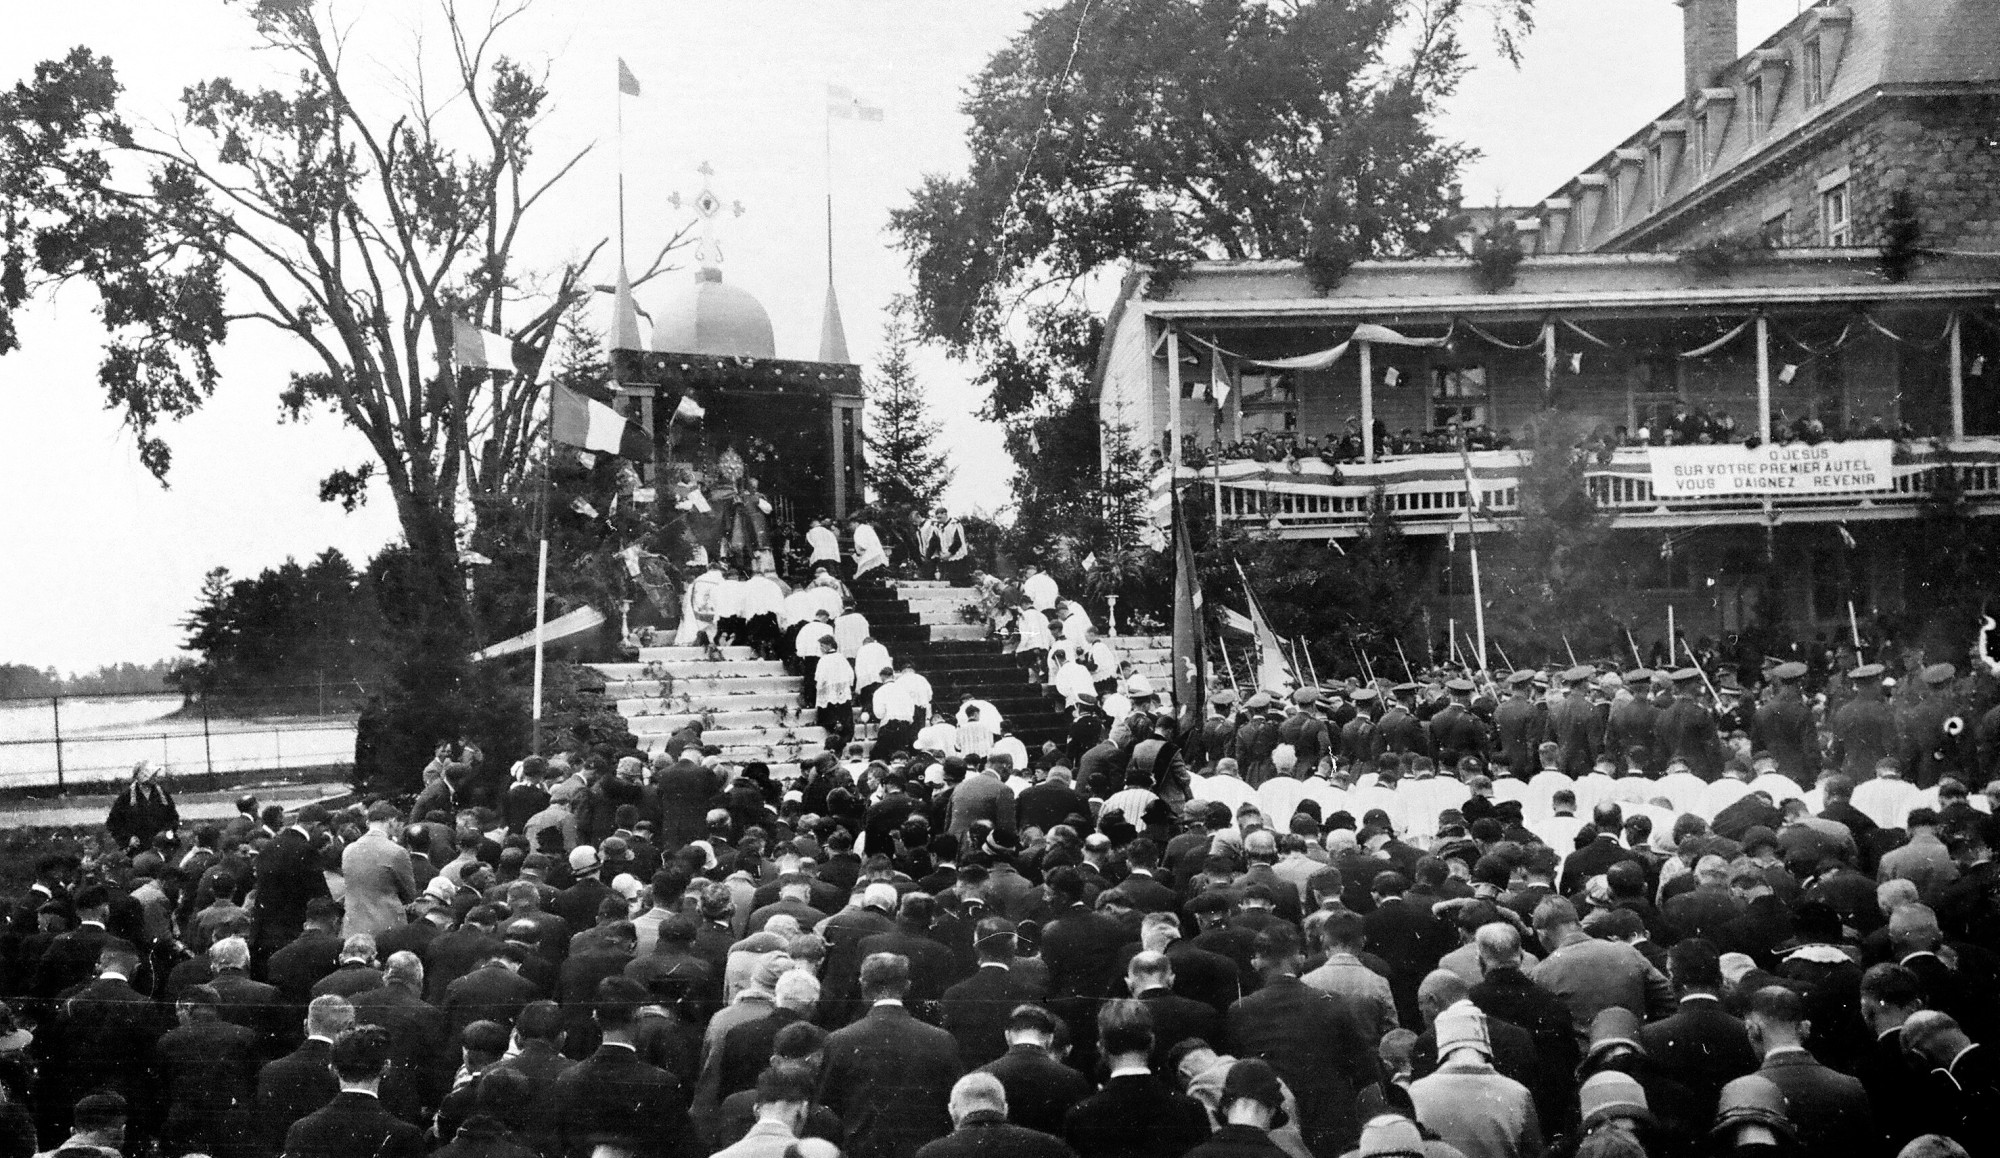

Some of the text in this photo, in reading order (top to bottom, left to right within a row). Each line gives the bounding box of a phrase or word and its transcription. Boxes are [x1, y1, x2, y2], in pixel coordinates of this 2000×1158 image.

[1769, 449, 1829, 461] O JESUS
[1674, 460, 1872, 476] SUR VOTRE PREMIER AUTEL
[1676, 474, 1875, 490] VOUS DAIGNEZ REVENIR
